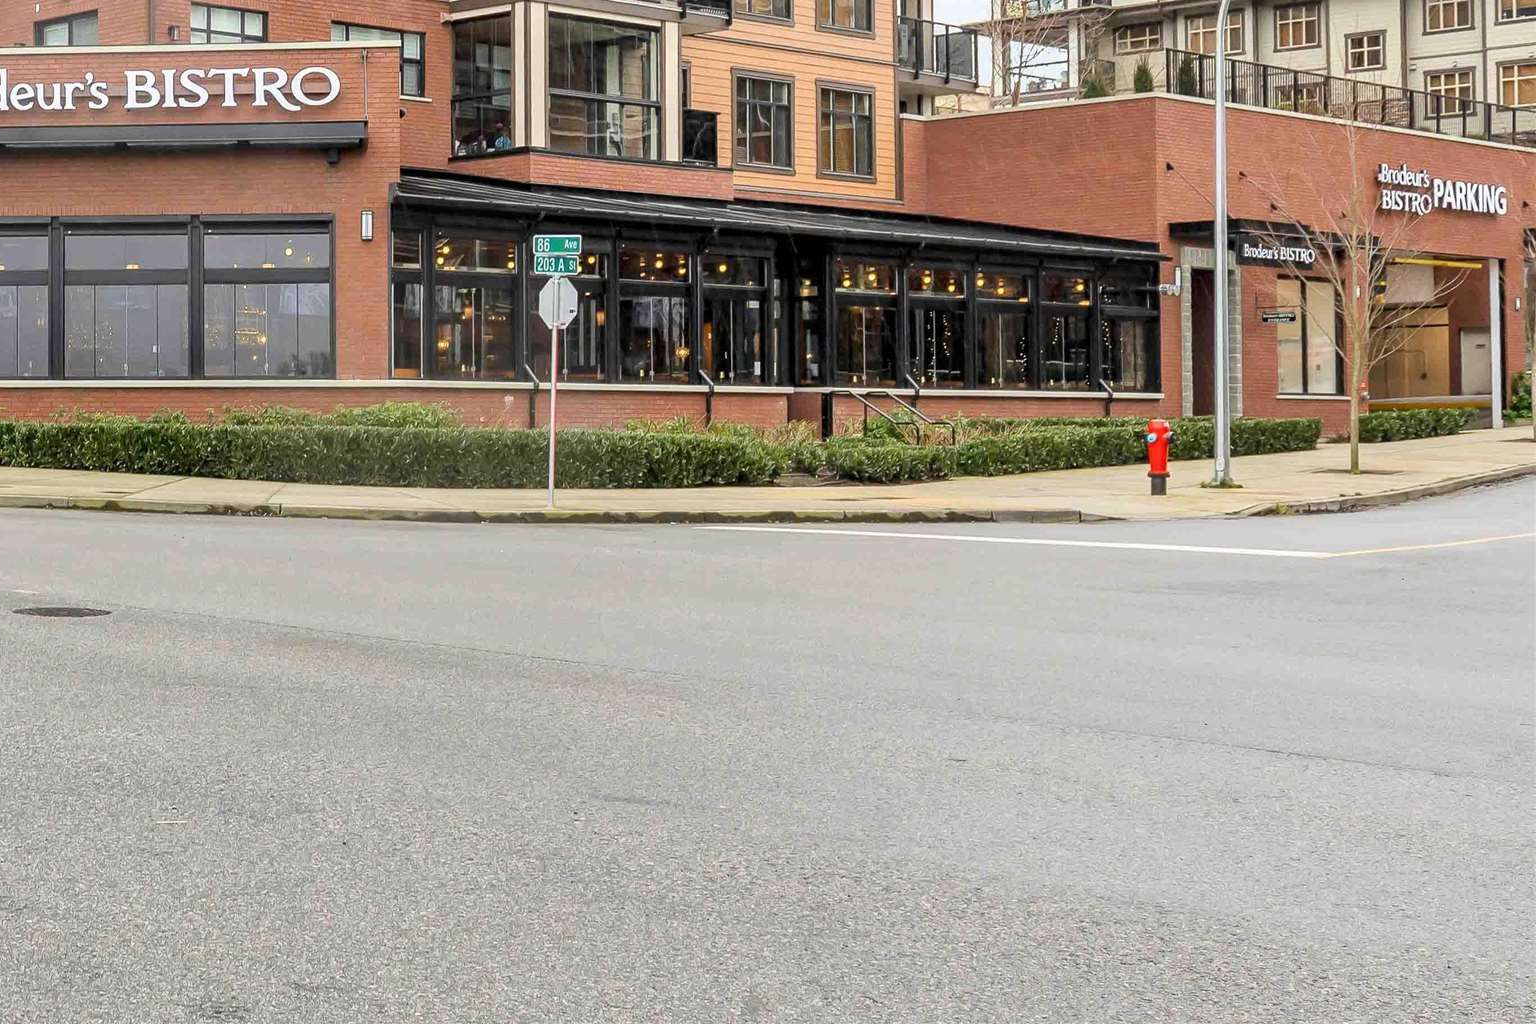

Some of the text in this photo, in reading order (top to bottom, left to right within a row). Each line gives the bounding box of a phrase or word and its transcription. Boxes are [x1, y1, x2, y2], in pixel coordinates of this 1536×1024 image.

[124, 66, 341, 111] BISTRO
[1380, 163, 1430, 188] Brodeur's
[1382, 189, 1432, 215] BISTRO
[1433, 178, 1507, 215] PARKING
[537, 238, 578, 252] 86 Ave
[1244, 243, 1315, 264] Brodeur's BISTRO
[537, 257, 555, 271] 203
[558, 257, 565, 272] A
